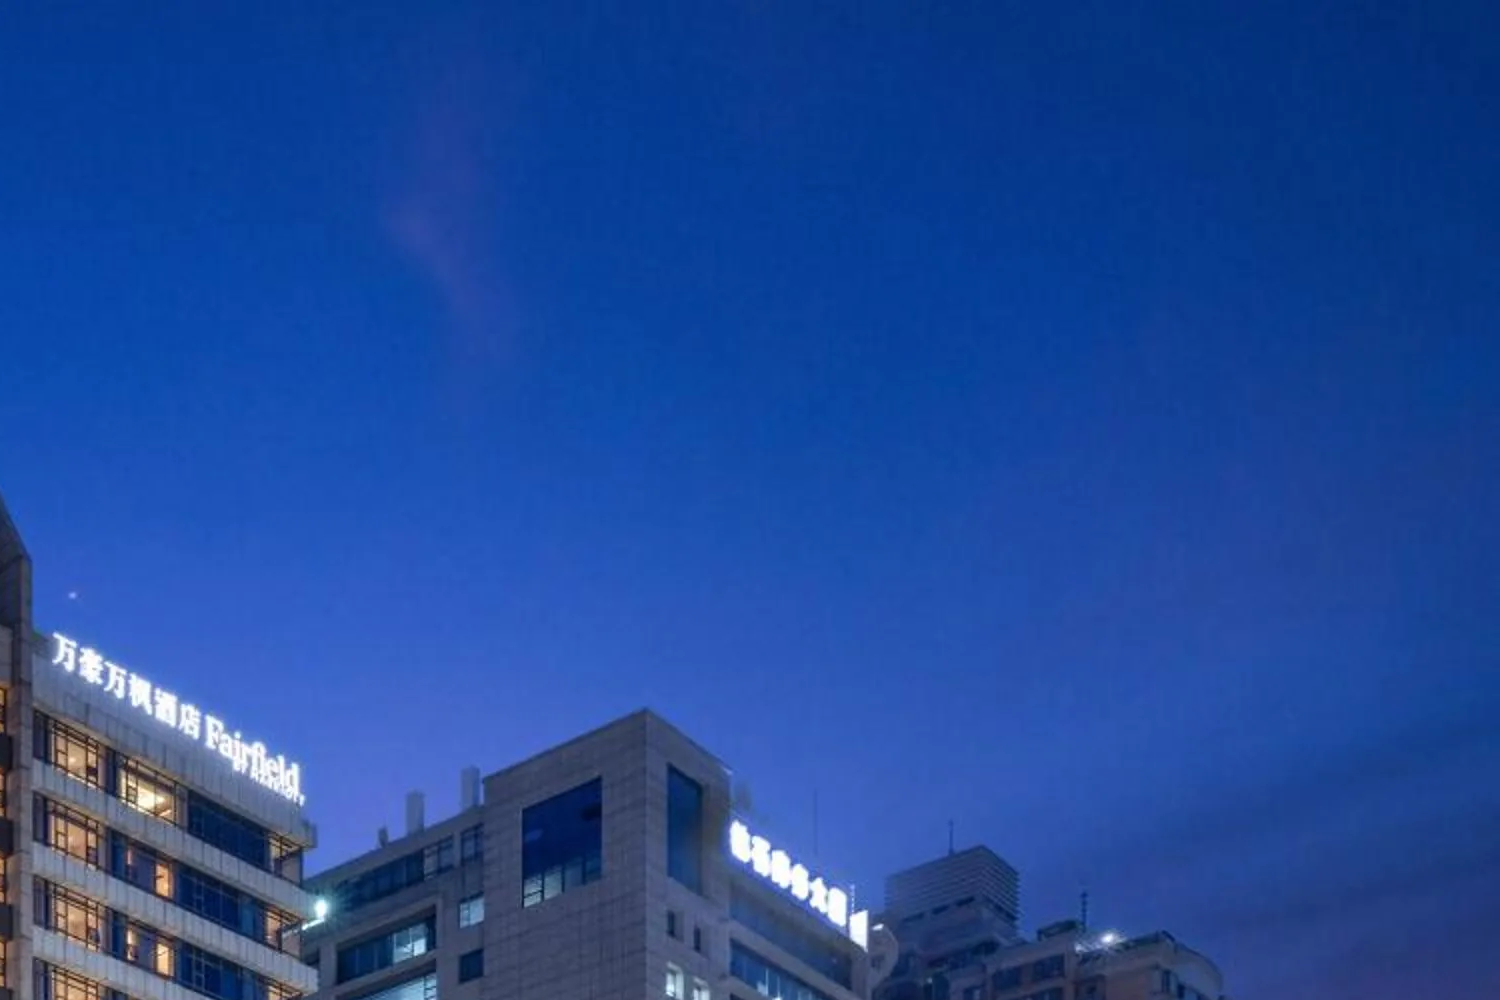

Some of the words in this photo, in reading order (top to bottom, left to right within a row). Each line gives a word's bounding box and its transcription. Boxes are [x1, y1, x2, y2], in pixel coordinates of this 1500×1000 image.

[51, 632, 202, 741] 万豪万枫酒店
[204, 714, 301, 796] Fairfield
